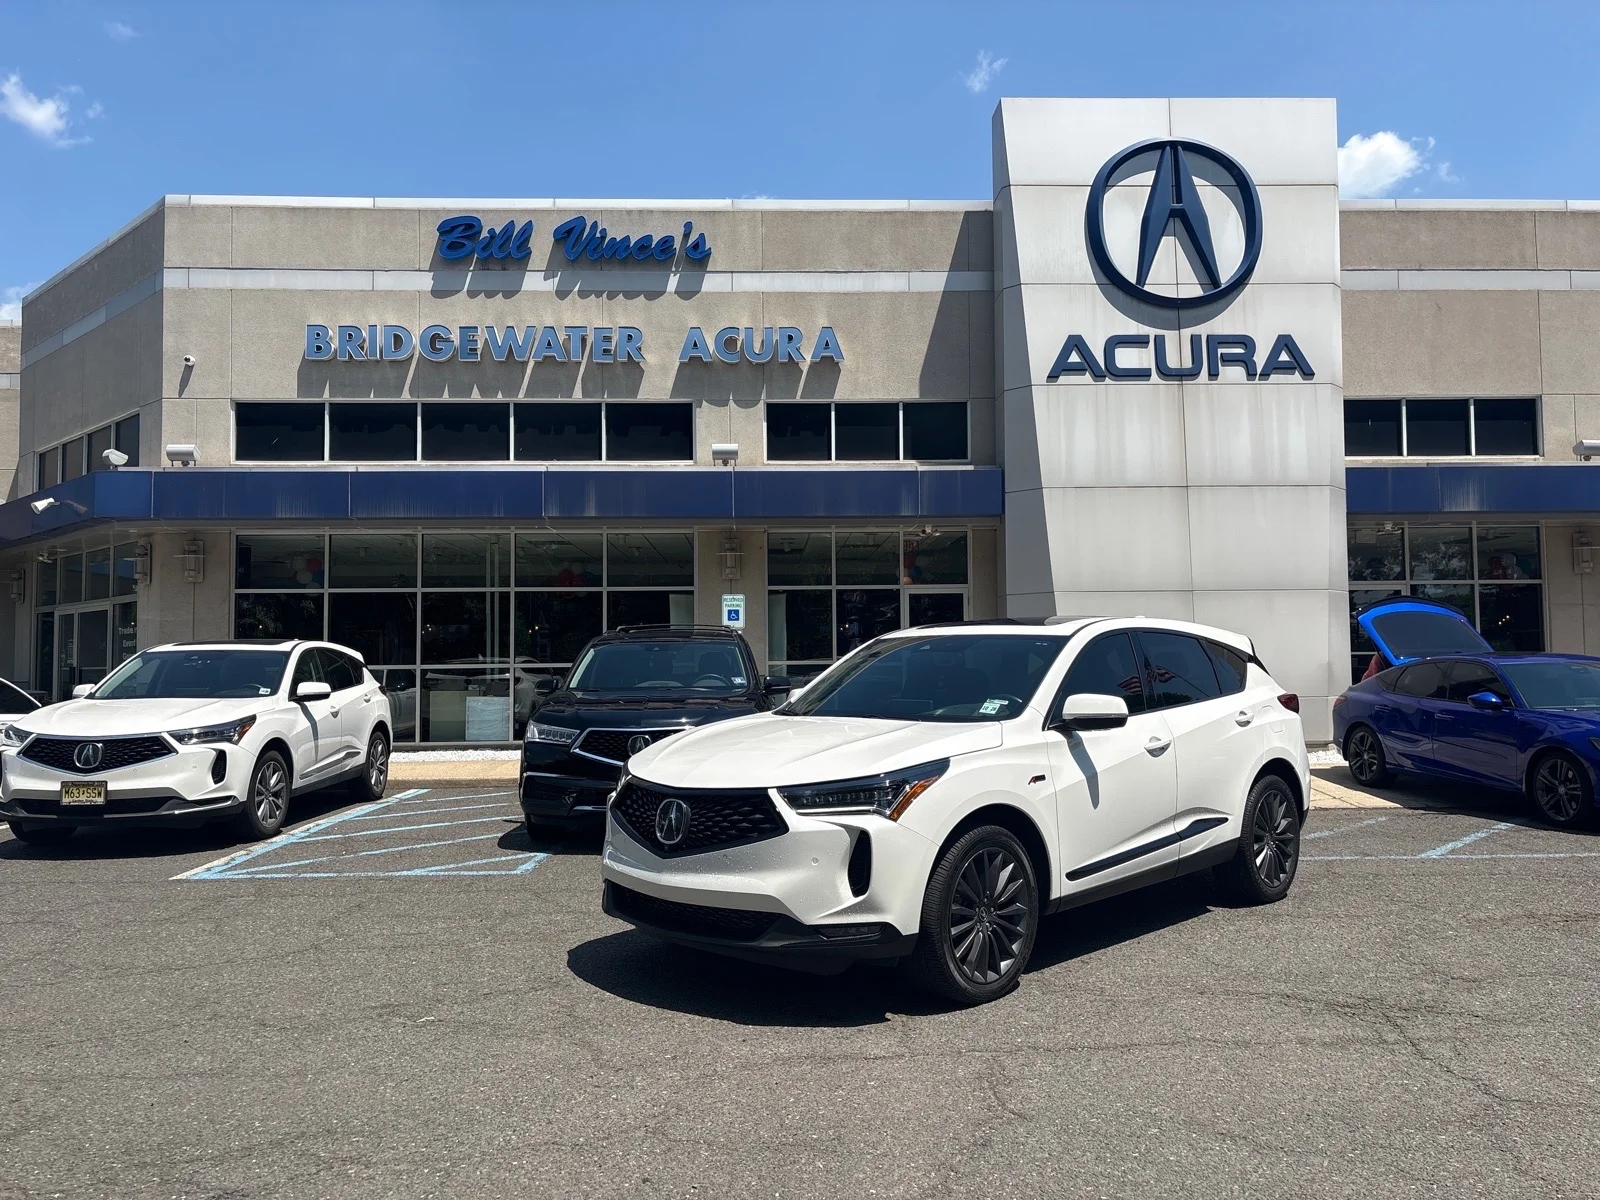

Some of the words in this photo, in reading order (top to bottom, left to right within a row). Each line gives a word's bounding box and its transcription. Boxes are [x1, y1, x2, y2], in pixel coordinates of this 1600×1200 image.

[437, 216, 533, 262] Bill
[552, 216, 712, 262] Vince's
[304, 324, 646, 363] BRIDGEWATER
[679, 326, 844, 363] ACURA
[1047, 334, 1315, 382] ACURA
[118, 627, 134, 635] Trade
